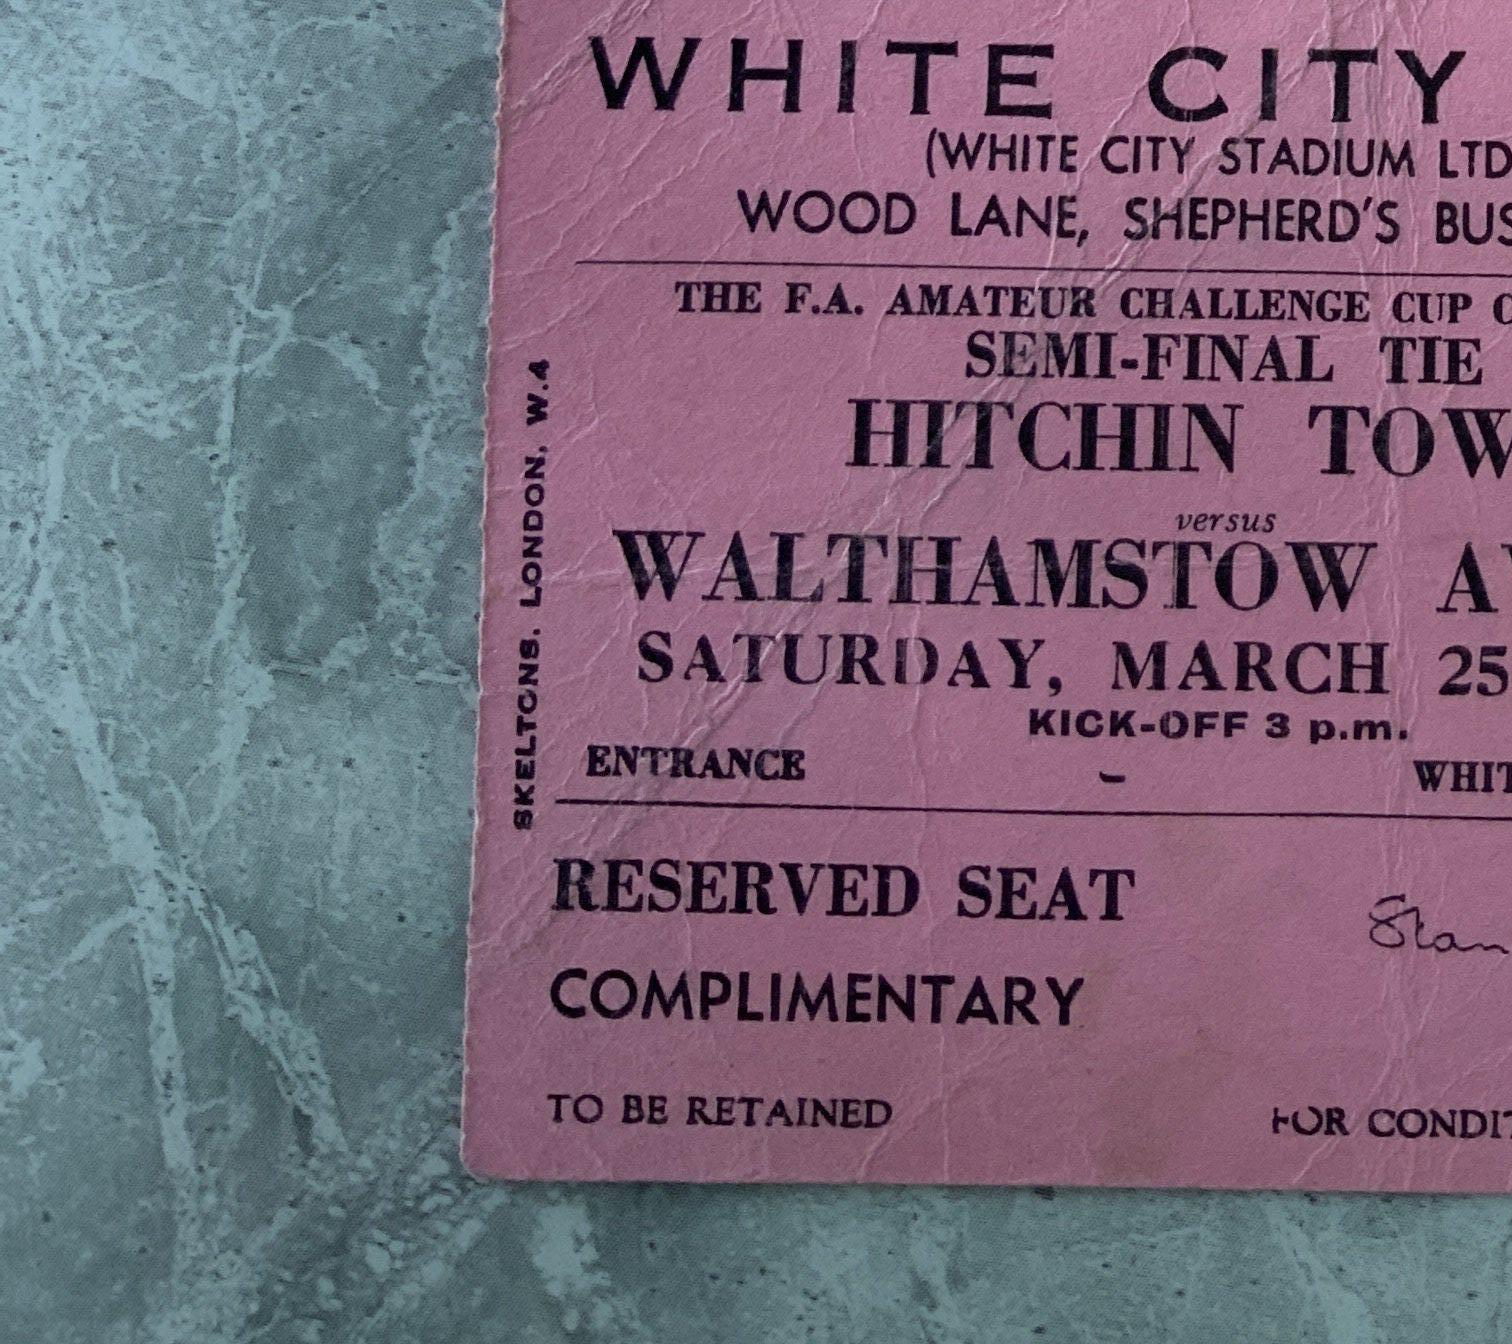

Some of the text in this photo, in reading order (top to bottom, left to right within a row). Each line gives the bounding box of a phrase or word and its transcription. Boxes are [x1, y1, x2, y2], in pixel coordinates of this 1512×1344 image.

[587, 35, 1055, 120] WHITE
[1147, 46, 1467, 125] CITY
[926, 127, 1079, 179] (WHITE
[1099, 135, 1196, 175] CITY
[1218, 137, 1416, 178] STADIUM
[736, 189, 917, 235] WOOD
[950, 191, 1089, 248] LANE,
[674, 281, 762, 314] THE
[784, 282, 864, 316] F.A.
[885, 283, 1097, 320] AMATEUR
[1119, 287, 1370, 323] CHALLENGE
[1392, 291, 1473, 324] CUP
[965, 329, 1483, 386] SEMI-FINAL TIE
[526, 359, 550, 426] W.4
[845, 398, 1244, 474] HITCHIN
[519, 446, 548, 608] LONDON,
[1177, 513, 1277, 534] versus
[612, 529, 1378, 613] WALTHAMSTOW
[637, 630, 1062, 697] SATURDAY,
[1111, 640, 1390, 695] MARCH
[1029, 708, 1408, 745] KICK-OFF 3 p.m.
[586, 744, 806, 781] ENTRANCE
[550, 858, 1136, 921] RESERVED SEAT
[549, 967, 1085, 1027] COMPLIMENTARY
[546, 1093, 893, 1129] TO BE RETAINED
[1271, 1106, 1350, 1136] FOR
